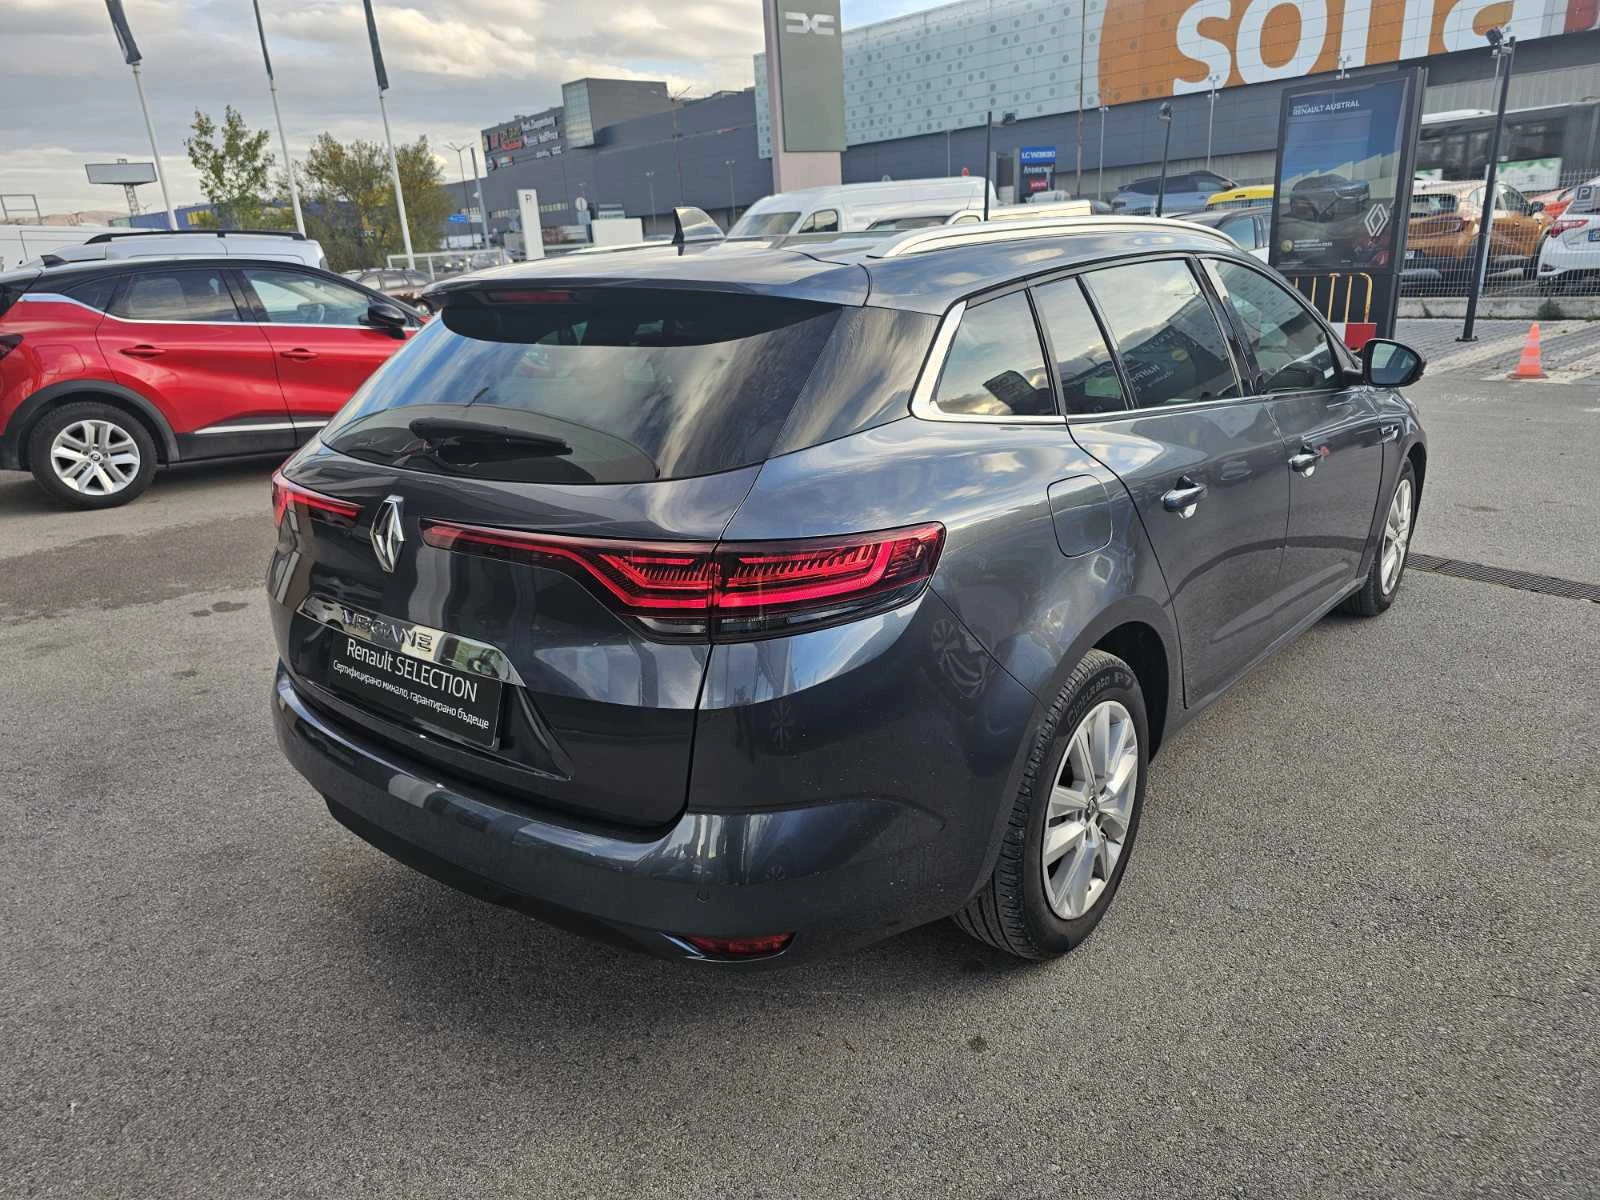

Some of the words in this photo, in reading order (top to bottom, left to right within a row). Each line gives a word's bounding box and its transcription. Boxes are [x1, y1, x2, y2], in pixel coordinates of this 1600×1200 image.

[1325, 100, 1360, 111] AUSTRAL
[1579, 188, 1590, 200] P
[346, 638, 394, 672] Renault
[394, 656, 478, 703] SELECTION
[332, 659, 382, 686] Сертифицирано
[382, 681, 410, 700] минало,
[410, 692, 457, 717] гарантирано
[457, 708, 490, 730] бъдеще
